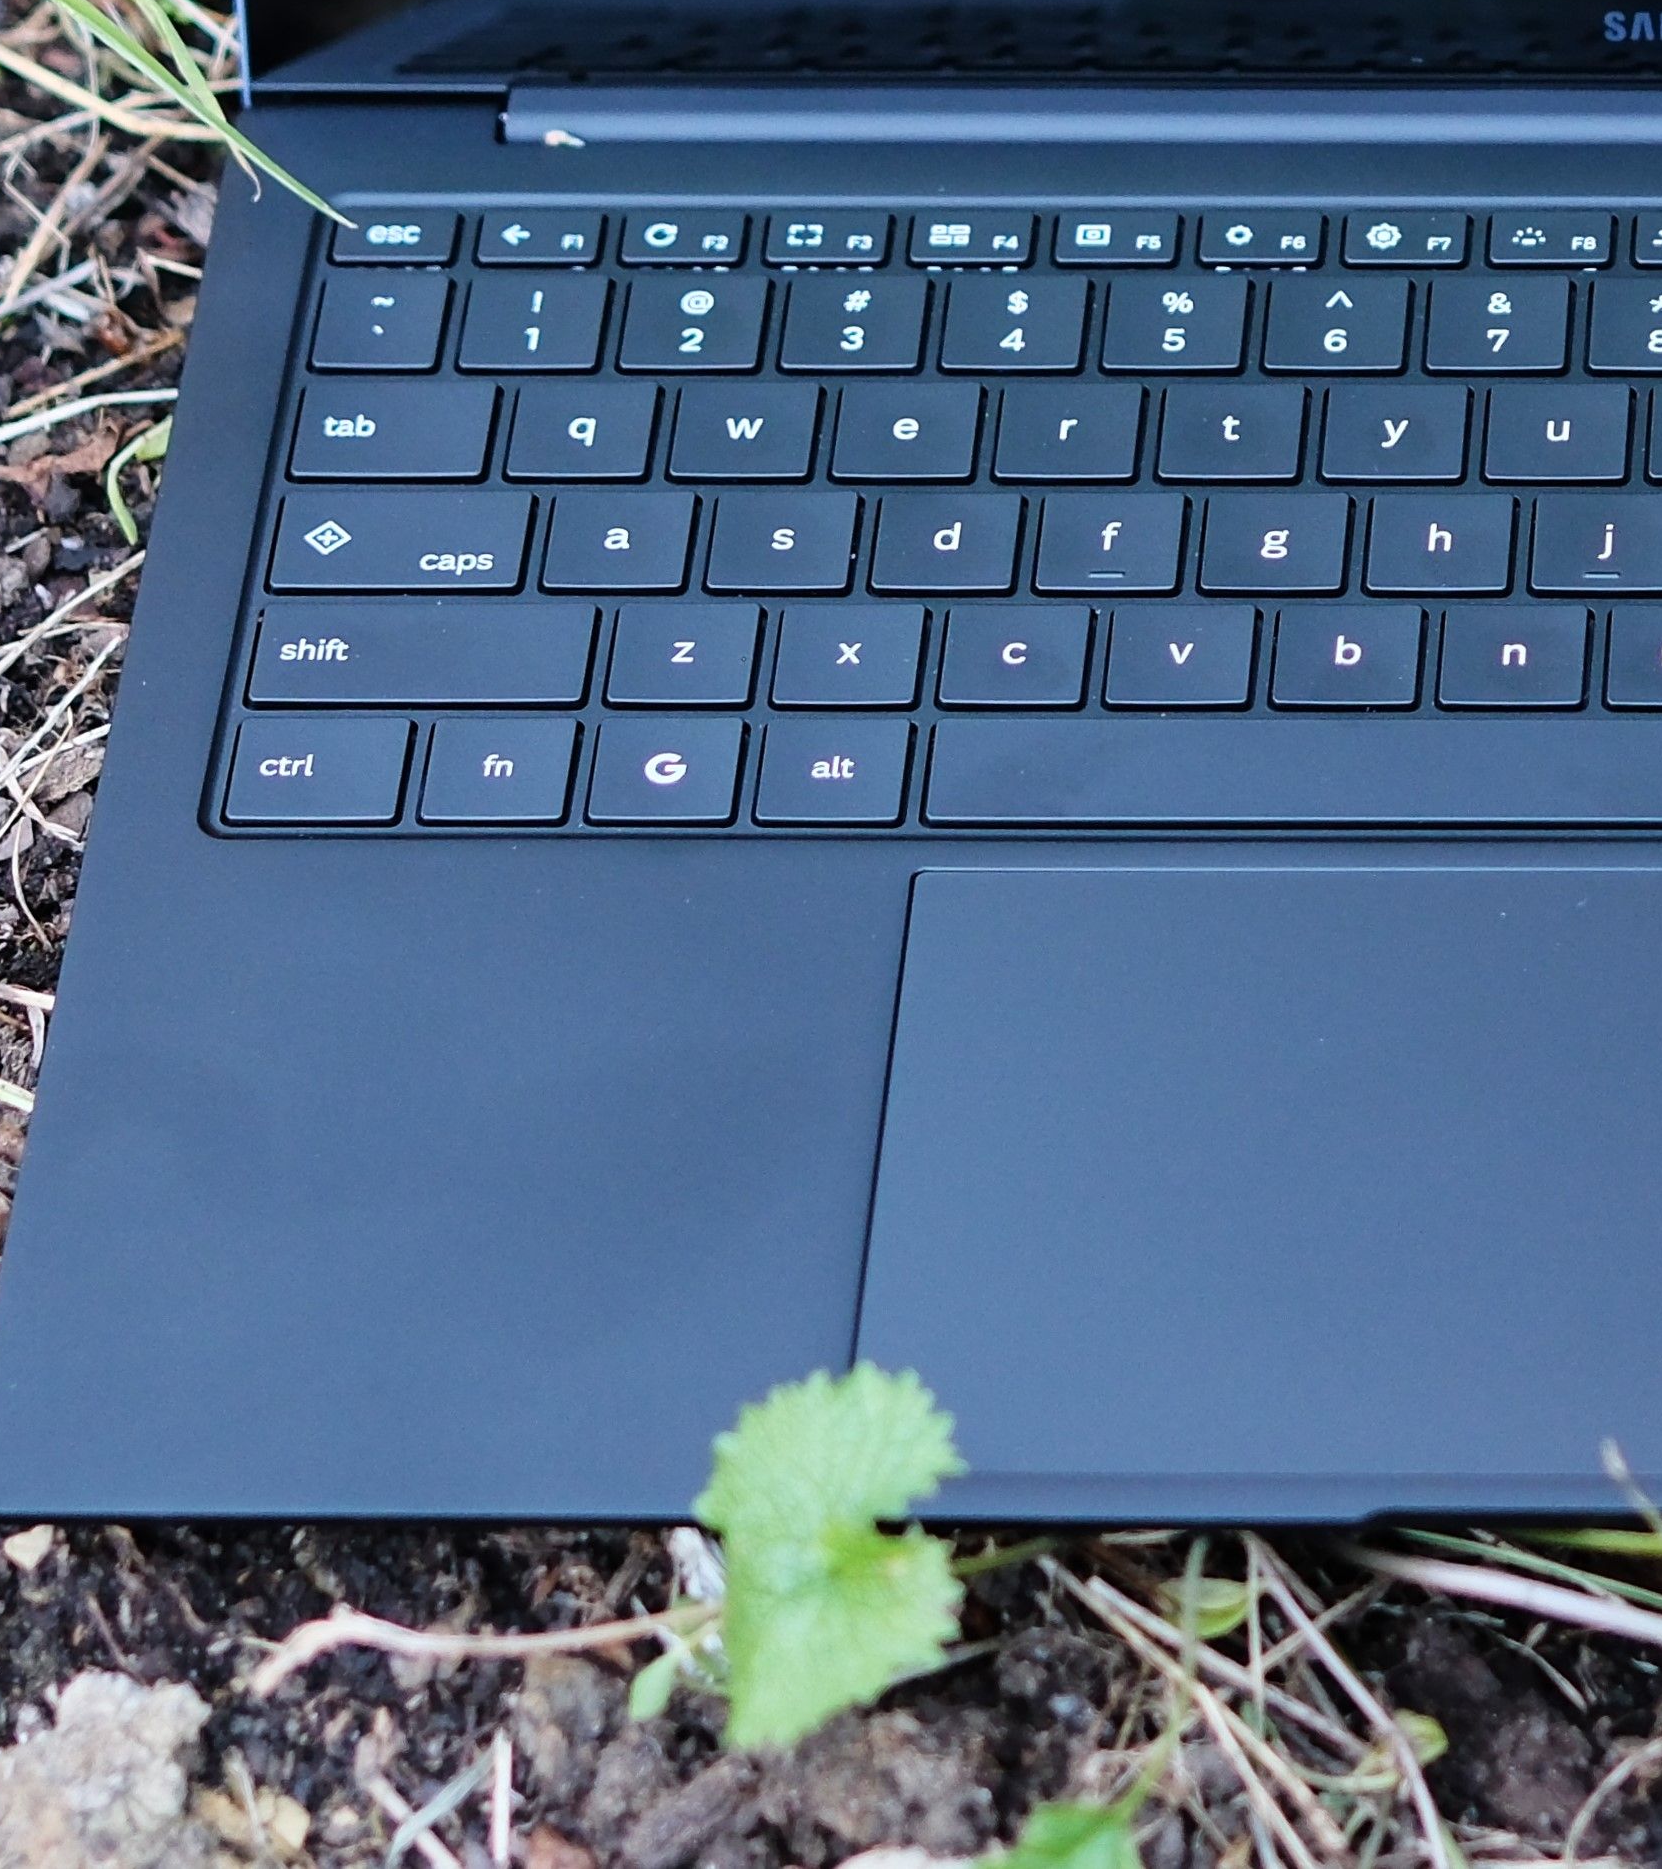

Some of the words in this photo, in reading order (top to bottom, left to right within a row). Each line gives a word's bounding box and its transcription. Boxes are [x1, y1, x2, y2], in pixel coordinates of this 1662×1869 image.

[366, 224, 422, 245] esc
[561, 234, 584, 250] F1
[701, 234, 729, 251] F2
[846, 234, 873, 250] F3
[992, 235, 1019, 250] F4
[1135, 235, 1162, 250] F5
[1280, 235, 1307, 250] F6
[1427, 236, 1452, 251] F7
[1571, 236, 1597, 251] F8
[524, 327, 540, 351] 1
[678, 327, 704, 353] 2
[840, 325, 865, 351] 3
[999, 327, 1026, 352] 4
[1161, 327, 1186, 352] 5
[1323, 328, 1348, 353] 6
[1486, 328, 1510, 353] 7
[324, 413, 376, 438] tab
[568, 417, 597, 447] q
[726, 417, 764, 440] w
[892, 417, 920, 440] e
[1059, 418, 1078, 441] r
[1222, 415, 1241, 441] t
[1381, 419, 1409, 448] y
[1546, 420, 1571, 442] u
[603, 527, 630, 550] a
[771, 528, 795, 551] s
[933, 521, 962, 551] d
[1101, 521, 1122, 551] f
[1260, 529, 1290, 559] g
[1427, 522, 1452, 552] h
[1597, 523, 1614, 560] j
[419, 553, 494, 576] caps
[279, 638, 350, 661] shift
[670, 641, 696, 663] z
[836, 642, 862, 665] x
[1002, 642, 1027, 665] c
[1169, 642, 1194, 665] v
[1334, 634, 1362, 665] b
[1502, 643, 1527, 666] n
[259, 753, 314, 777] ctrl
[482, 753, 514, 777] fn
[644, 752, 688, 785] G
[811, 755, 855, 779] alt
